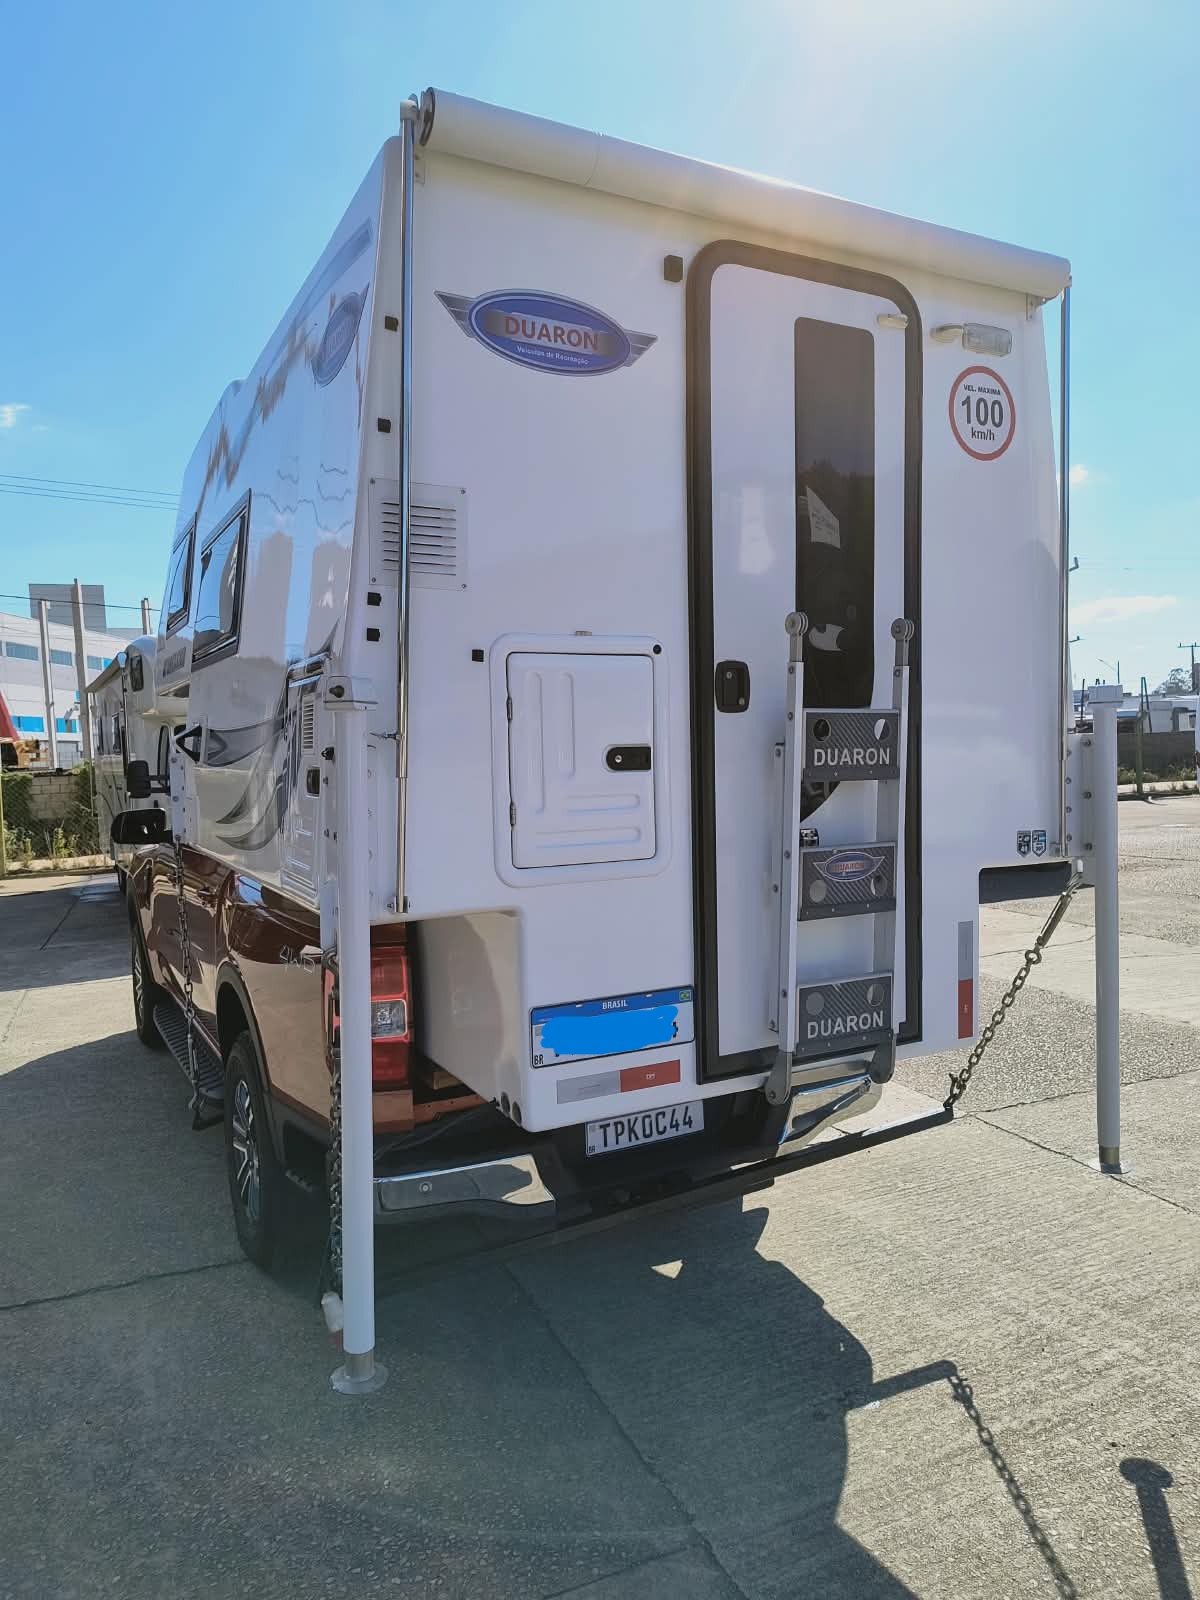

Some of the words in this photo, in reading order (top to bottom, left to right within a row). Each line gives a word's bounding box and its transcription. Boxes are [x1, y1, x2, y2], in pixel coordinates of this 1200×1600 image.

[504, 315, 599, 351] DUARON
[963, 383, 977, 392] VEL.
[961, 395, 1004, 428] 100
[971, 426, 995, 441] km/h
[813, 747, 890, 766] DUARON
[602, 1000, 628, 1010] BRASIL
[807, 1010, 884, 1039] DUARON
[533, 1053, 544, 1066] BR
